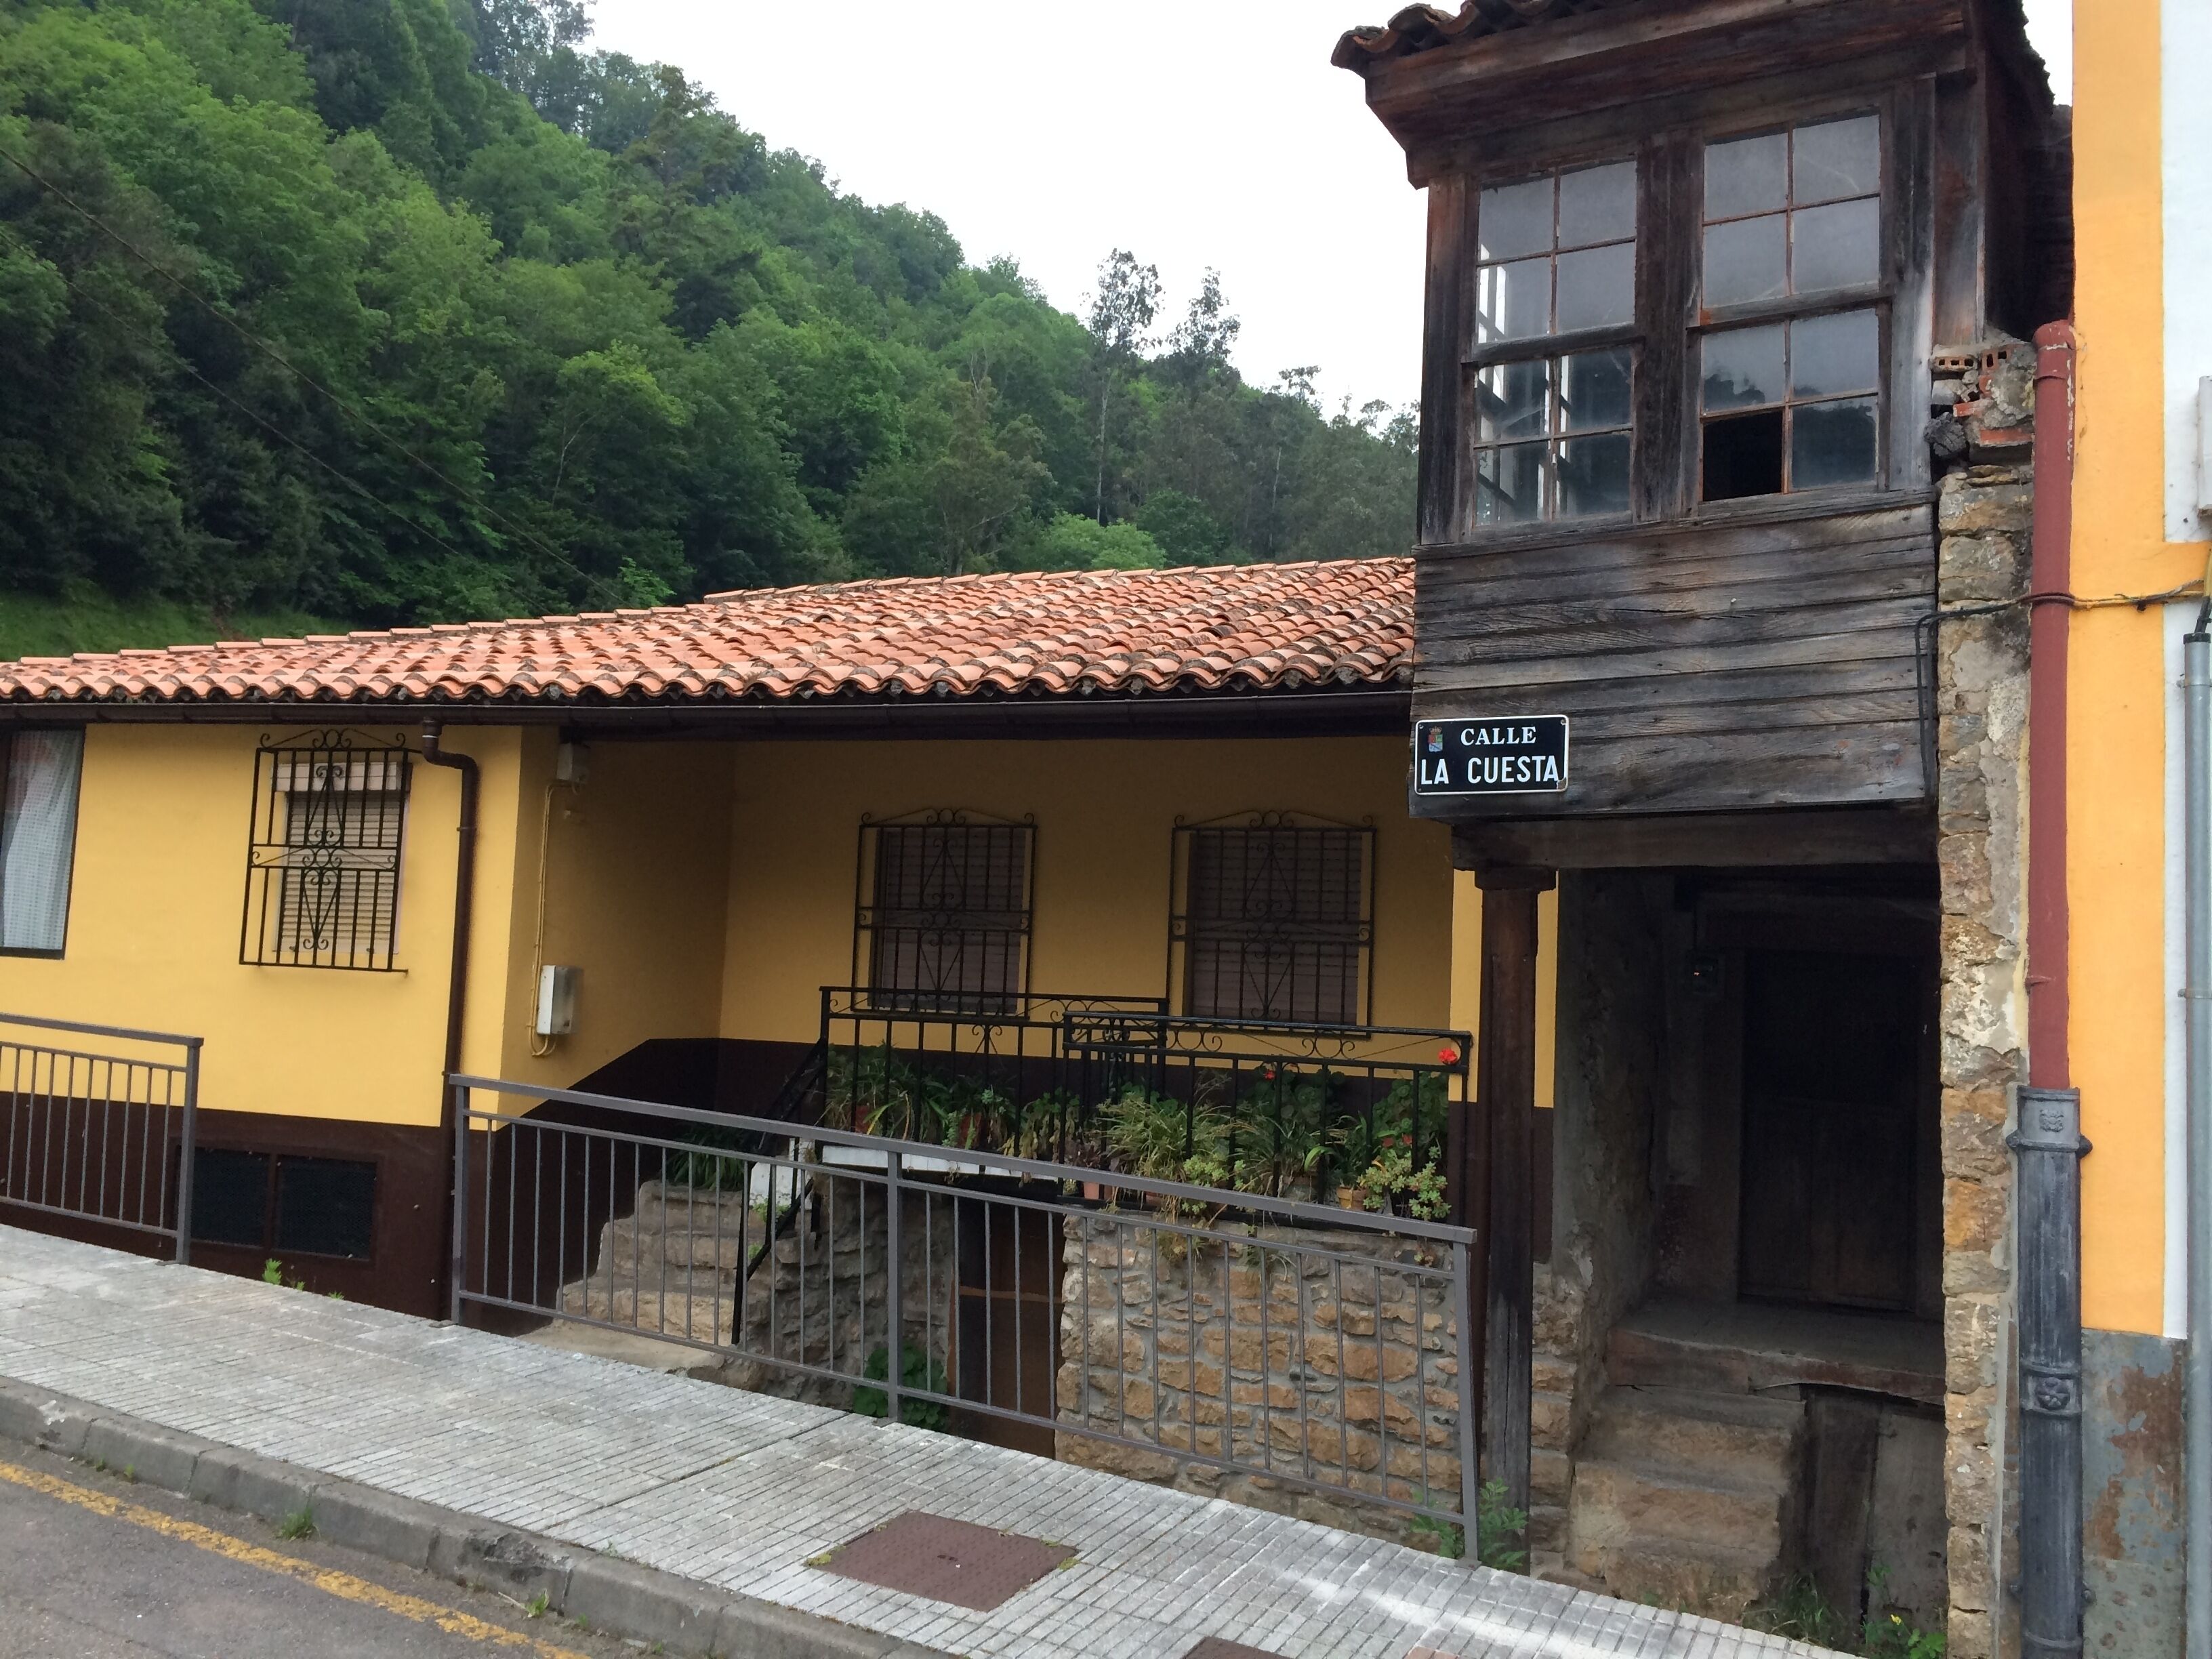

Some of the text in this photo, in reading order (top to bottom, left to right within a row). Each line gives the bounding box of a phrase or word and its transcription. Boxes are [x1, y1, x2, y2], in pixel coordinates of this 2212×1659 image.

[1460, 726, 1536, 745] CALLE
[1421, 756, 1559, 785] LA CUESTA
